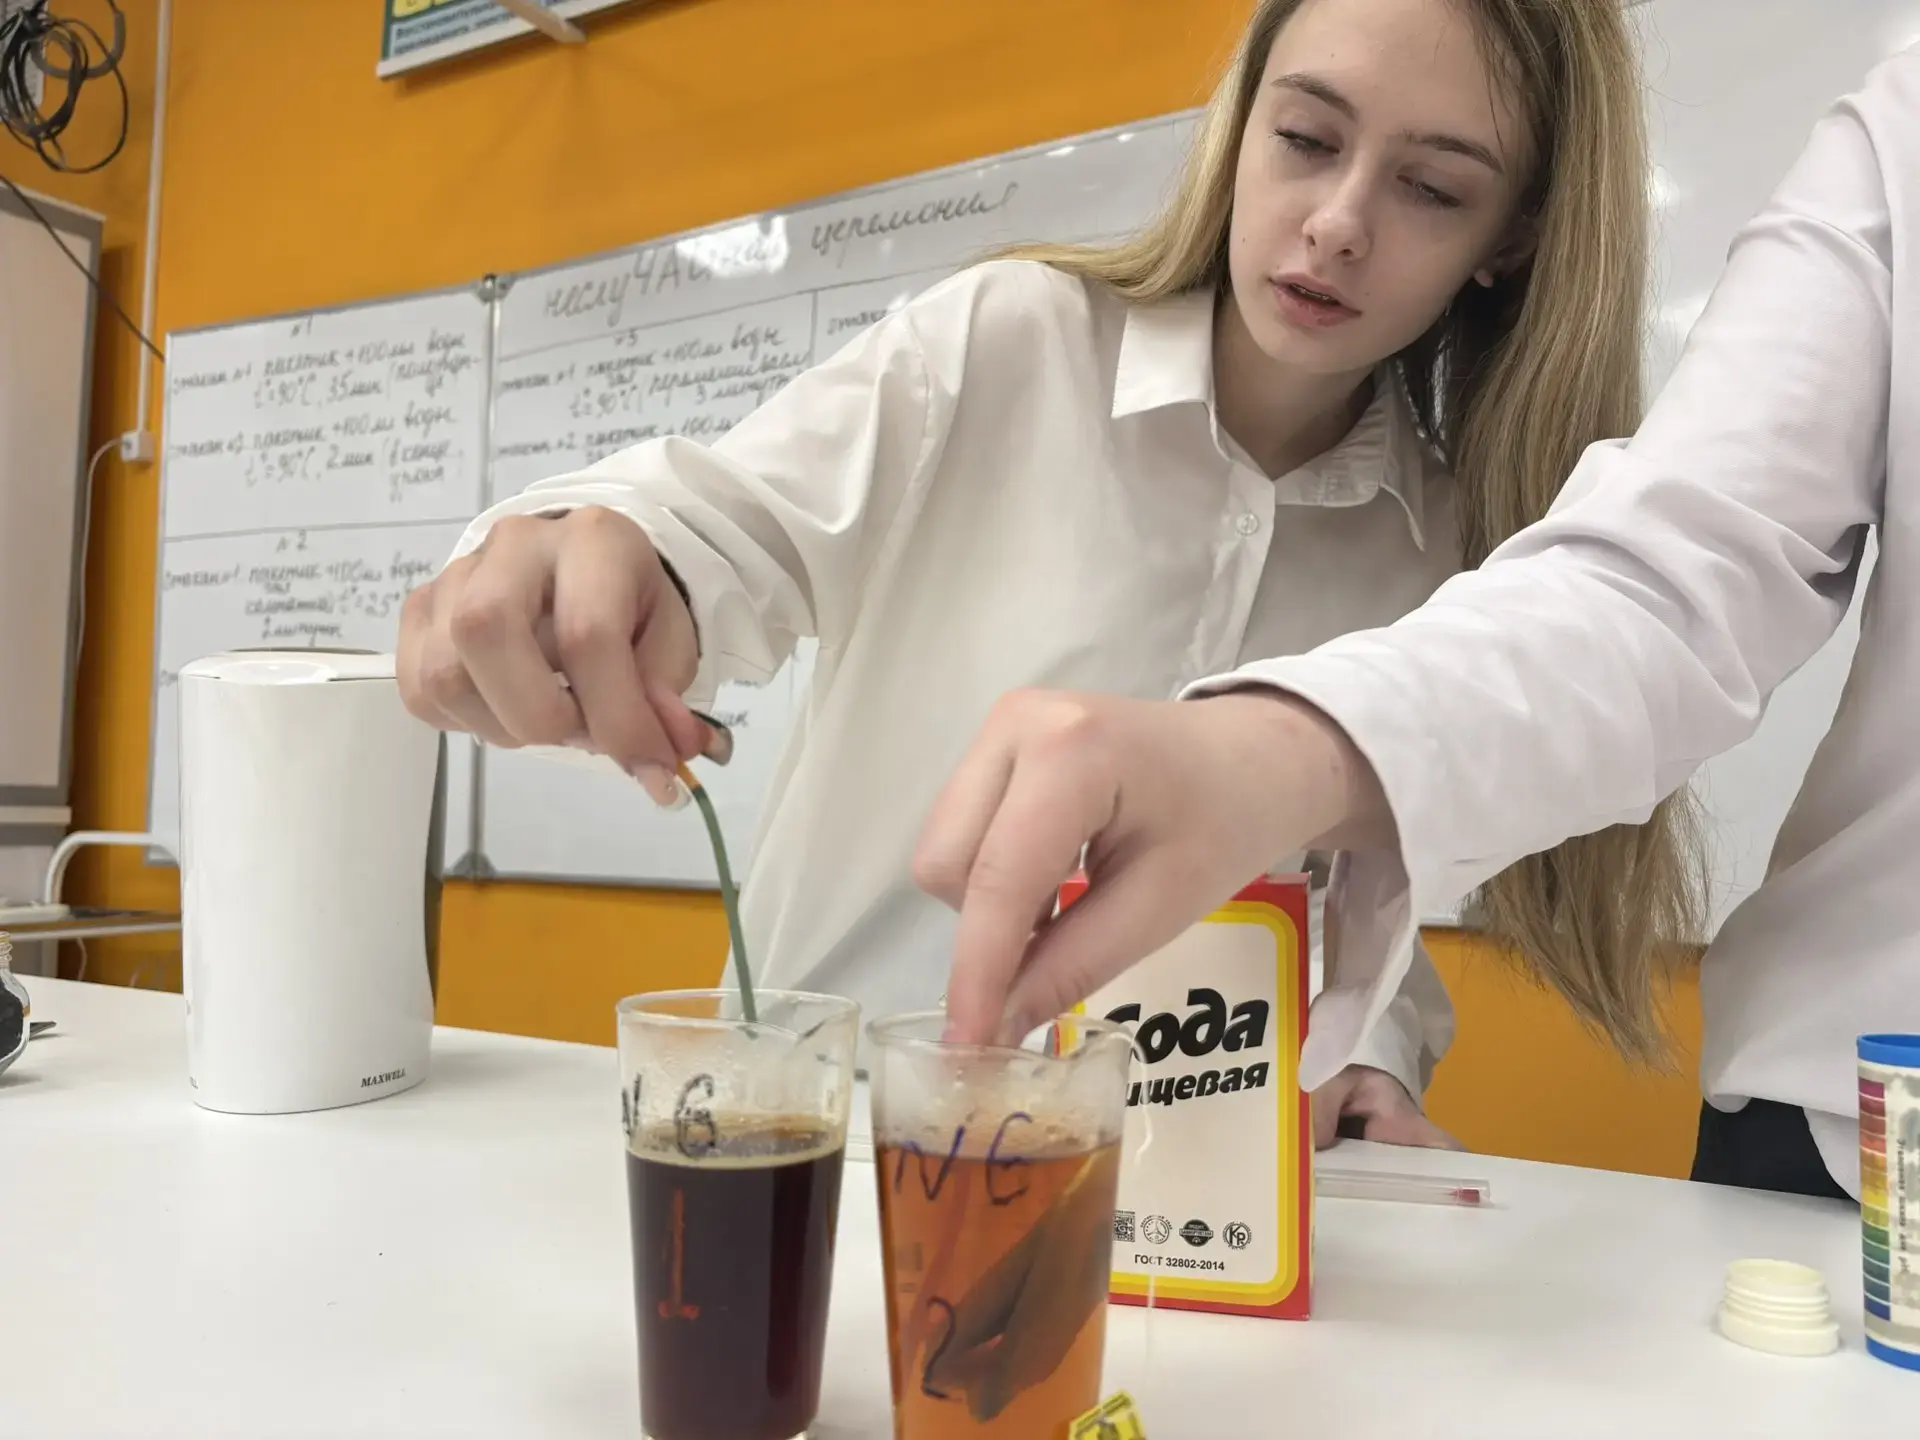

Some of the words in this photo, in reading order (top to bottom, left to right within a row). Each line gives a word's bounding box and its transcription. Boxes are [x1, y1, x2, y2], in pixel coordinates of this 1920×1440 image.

[360, 1067, 407, 1088] MAXWELL
[1124, 1061, 1270, 1107] ищевая
[1134, 1253, 1163, 1266] ГОСТ
[1165, 1257, 1225, 1271] 32802-2014
